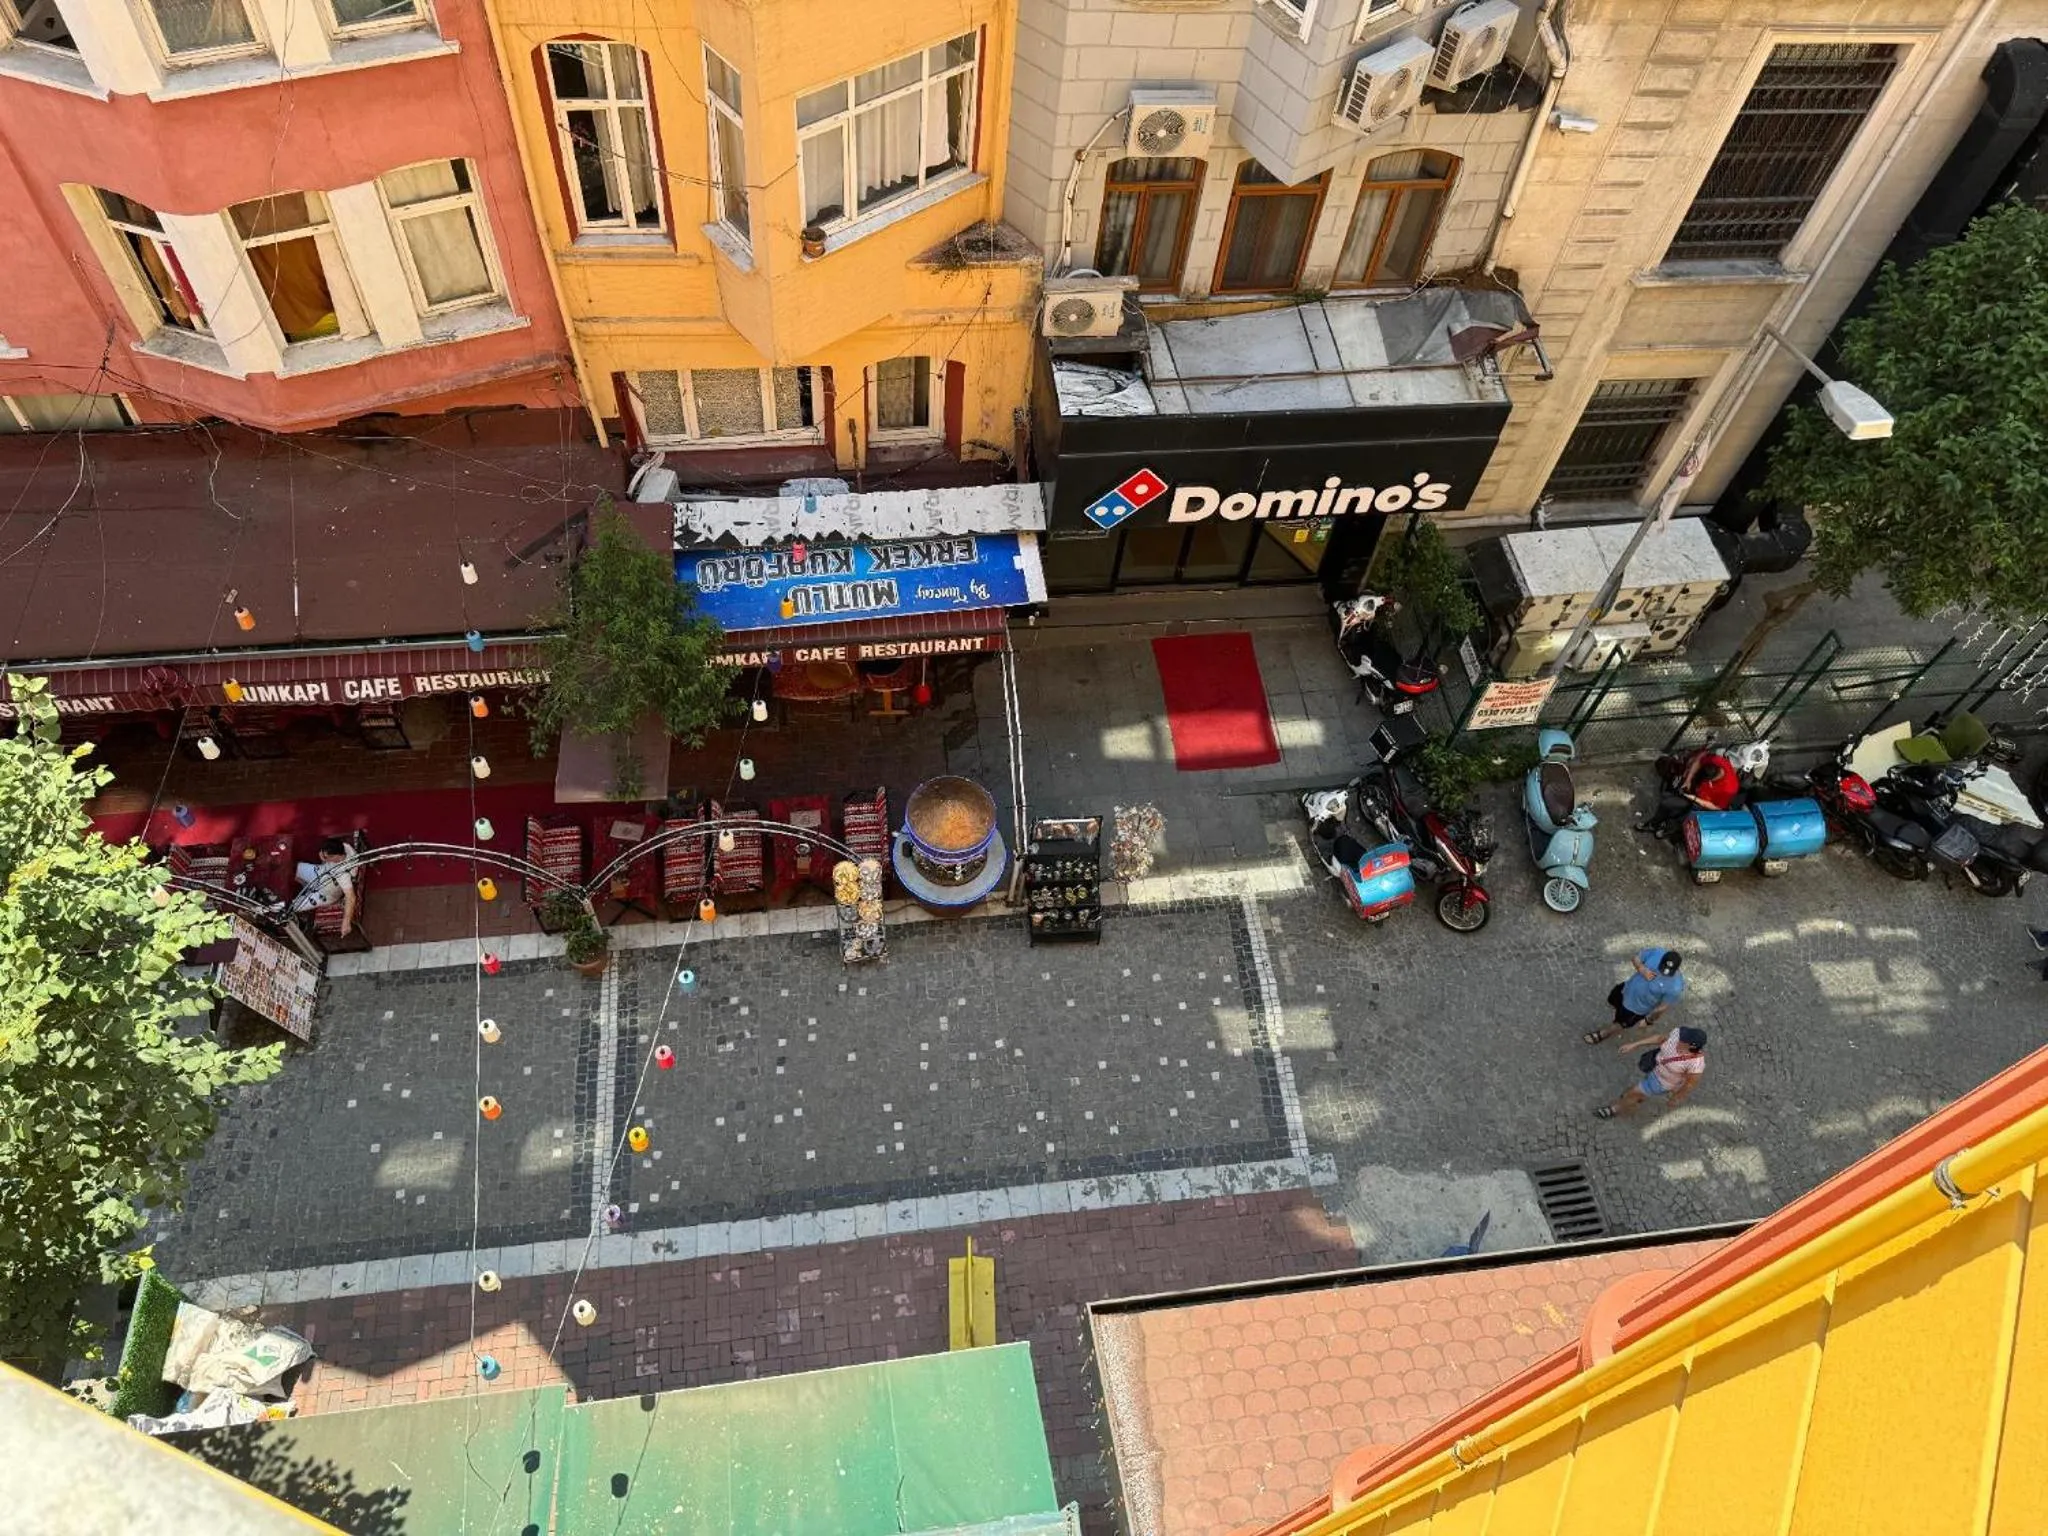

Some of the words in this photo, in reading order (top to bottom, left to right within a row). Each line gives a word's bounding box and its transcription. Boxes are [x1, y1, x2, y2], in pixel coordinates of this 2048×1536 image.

[1168, 472, 1451, 523] Domino's
[866, 536, 978, 574] ERKEK
[696, 547, 855, 593] KUAFÖRÜ
[788, 577, 898, 616] MUTLU
[917, 584, 968, 603] Tuncay
[970, 578, 990, 599] By
[795, 646, 846, 662] CAFE
[860, 637, 984, 658] RESTAURANT
[237, 681, 331, 703] UMKAPI
[344, 677, 402, 700] CAFE
[0, 696, 115, 718] STRANT
